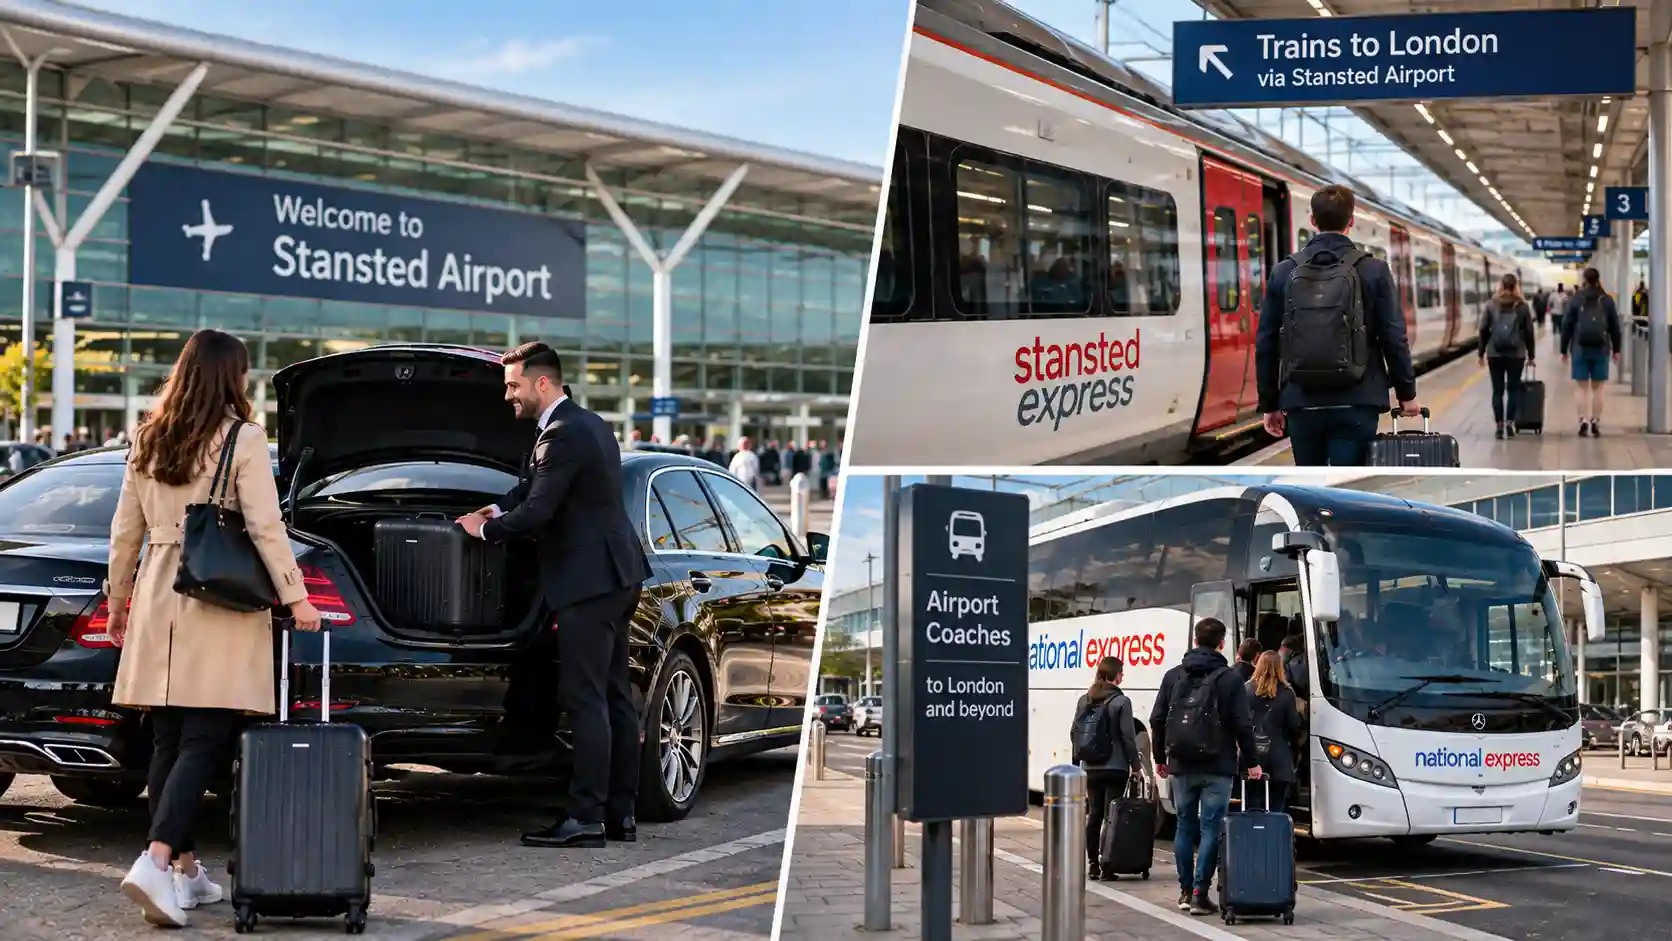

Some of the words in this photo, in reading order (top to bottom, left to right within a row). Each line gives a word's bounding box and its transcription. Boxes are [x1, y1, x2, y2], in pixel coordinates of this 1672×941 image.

[1256, 33, 1342, 60] Trains
[1350, 33, 1380, 57] to
[1389, 27, 1498, 56] London
[1257, 68, 1286, 87] via
[1291, 66, 1379, 86] Stansted
[1385, 65, 1455, 88] Airport
[273, 194, 392, 235] Welcome
[398, 211, 424, 238] to
[1616, 194, 1631, 214] 3
[272, 234, 429, 289] Stansted
[437, 253, 552, 304] Airport
[1014, 328, 1140, 384] stansted
[1017, 375, 1135, 432] express
[926, 590, 999, 619] Airport
[926, 621, 1011, 646] Coaches
[1028, 629, 1083, 670] ational
[926, 676, 943, 694] to
[948, 676, 1004, 694] London
[926, 700, 955, 717] and
[959, 700, 1014, 720] beyond
[1415, 747, 1482, 768] national
[1484, 752, 1541, 771] express
